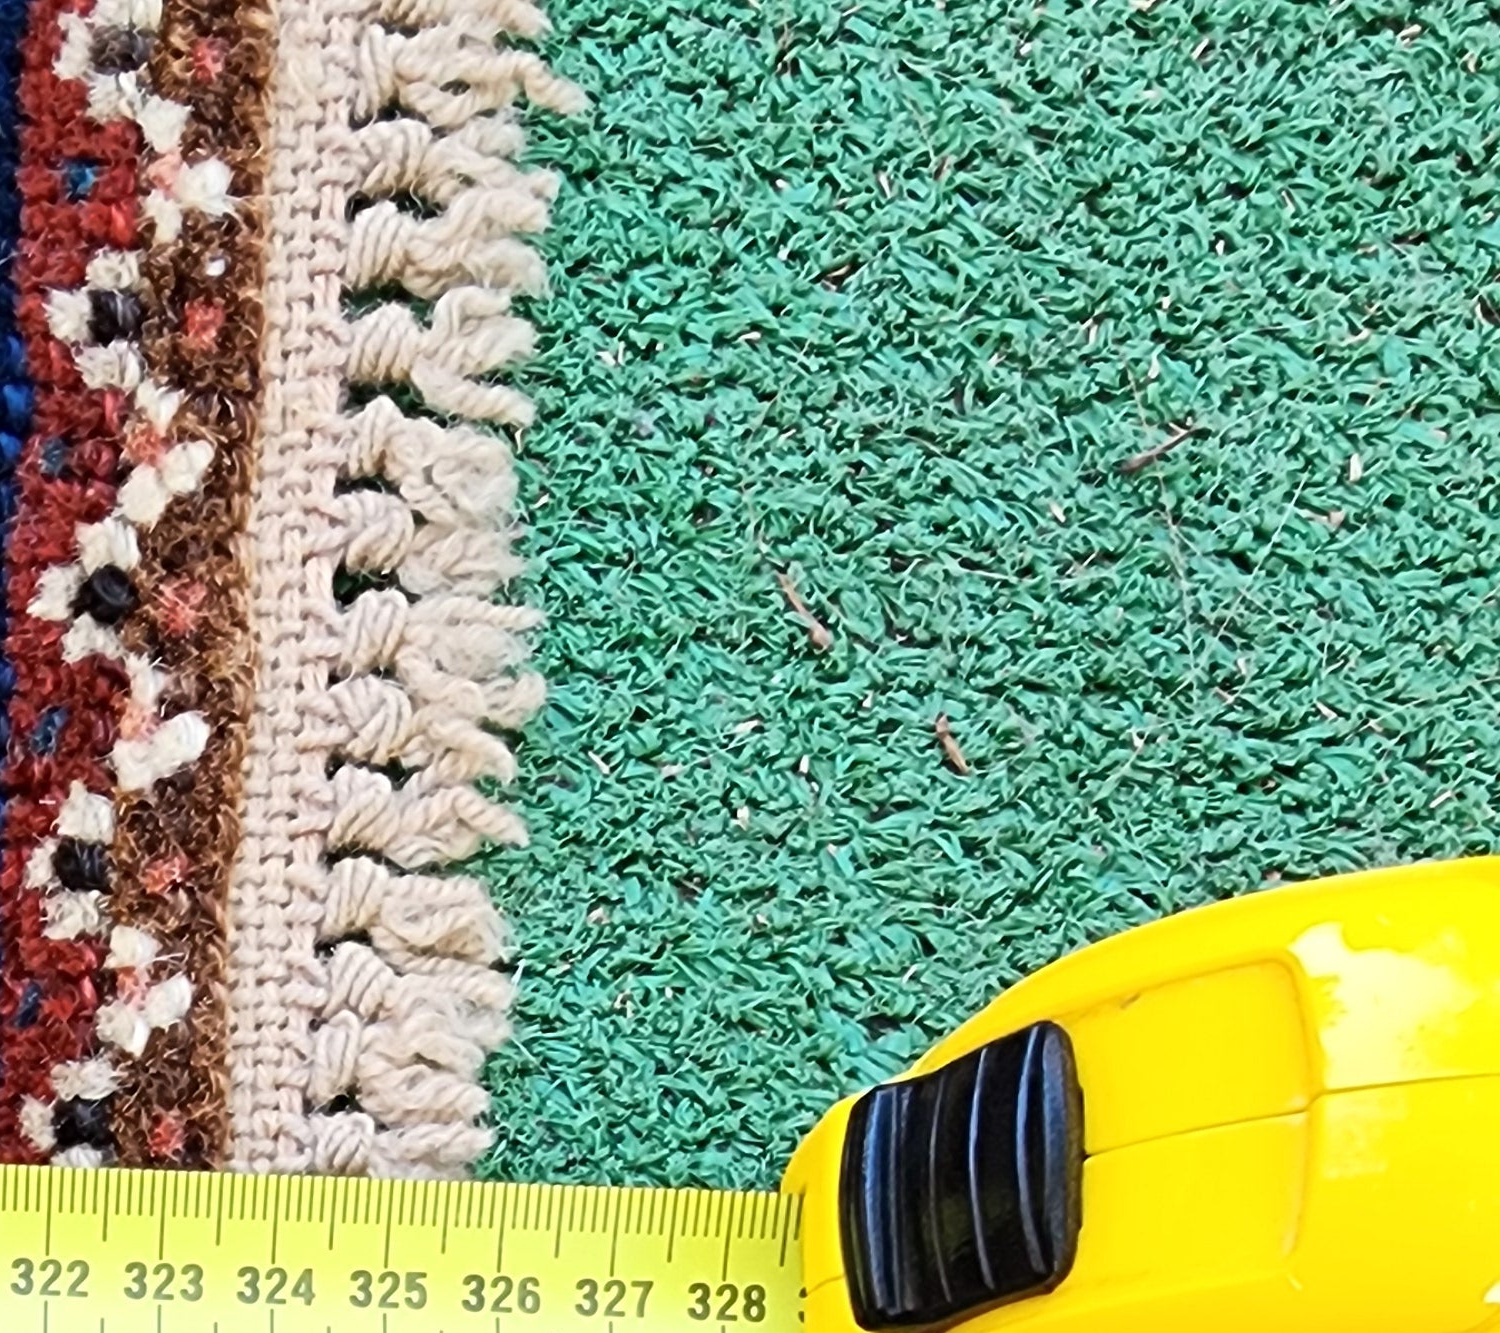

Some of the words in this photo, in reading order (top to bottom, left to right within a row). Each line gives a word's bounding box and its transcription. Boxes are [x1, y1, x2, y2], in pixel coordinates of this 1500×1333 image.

[10, 1258, 89, 1298] 322
[123, 1262, 204, 1303] 323
[236, 1266, 316, 1307] 324
[349, 1270, 428, 1310] 325
[461, 1274, 541, 1314] 326
[574, 1279, 654, 1318] 327
[686, 1282, 767, 1323] 328
